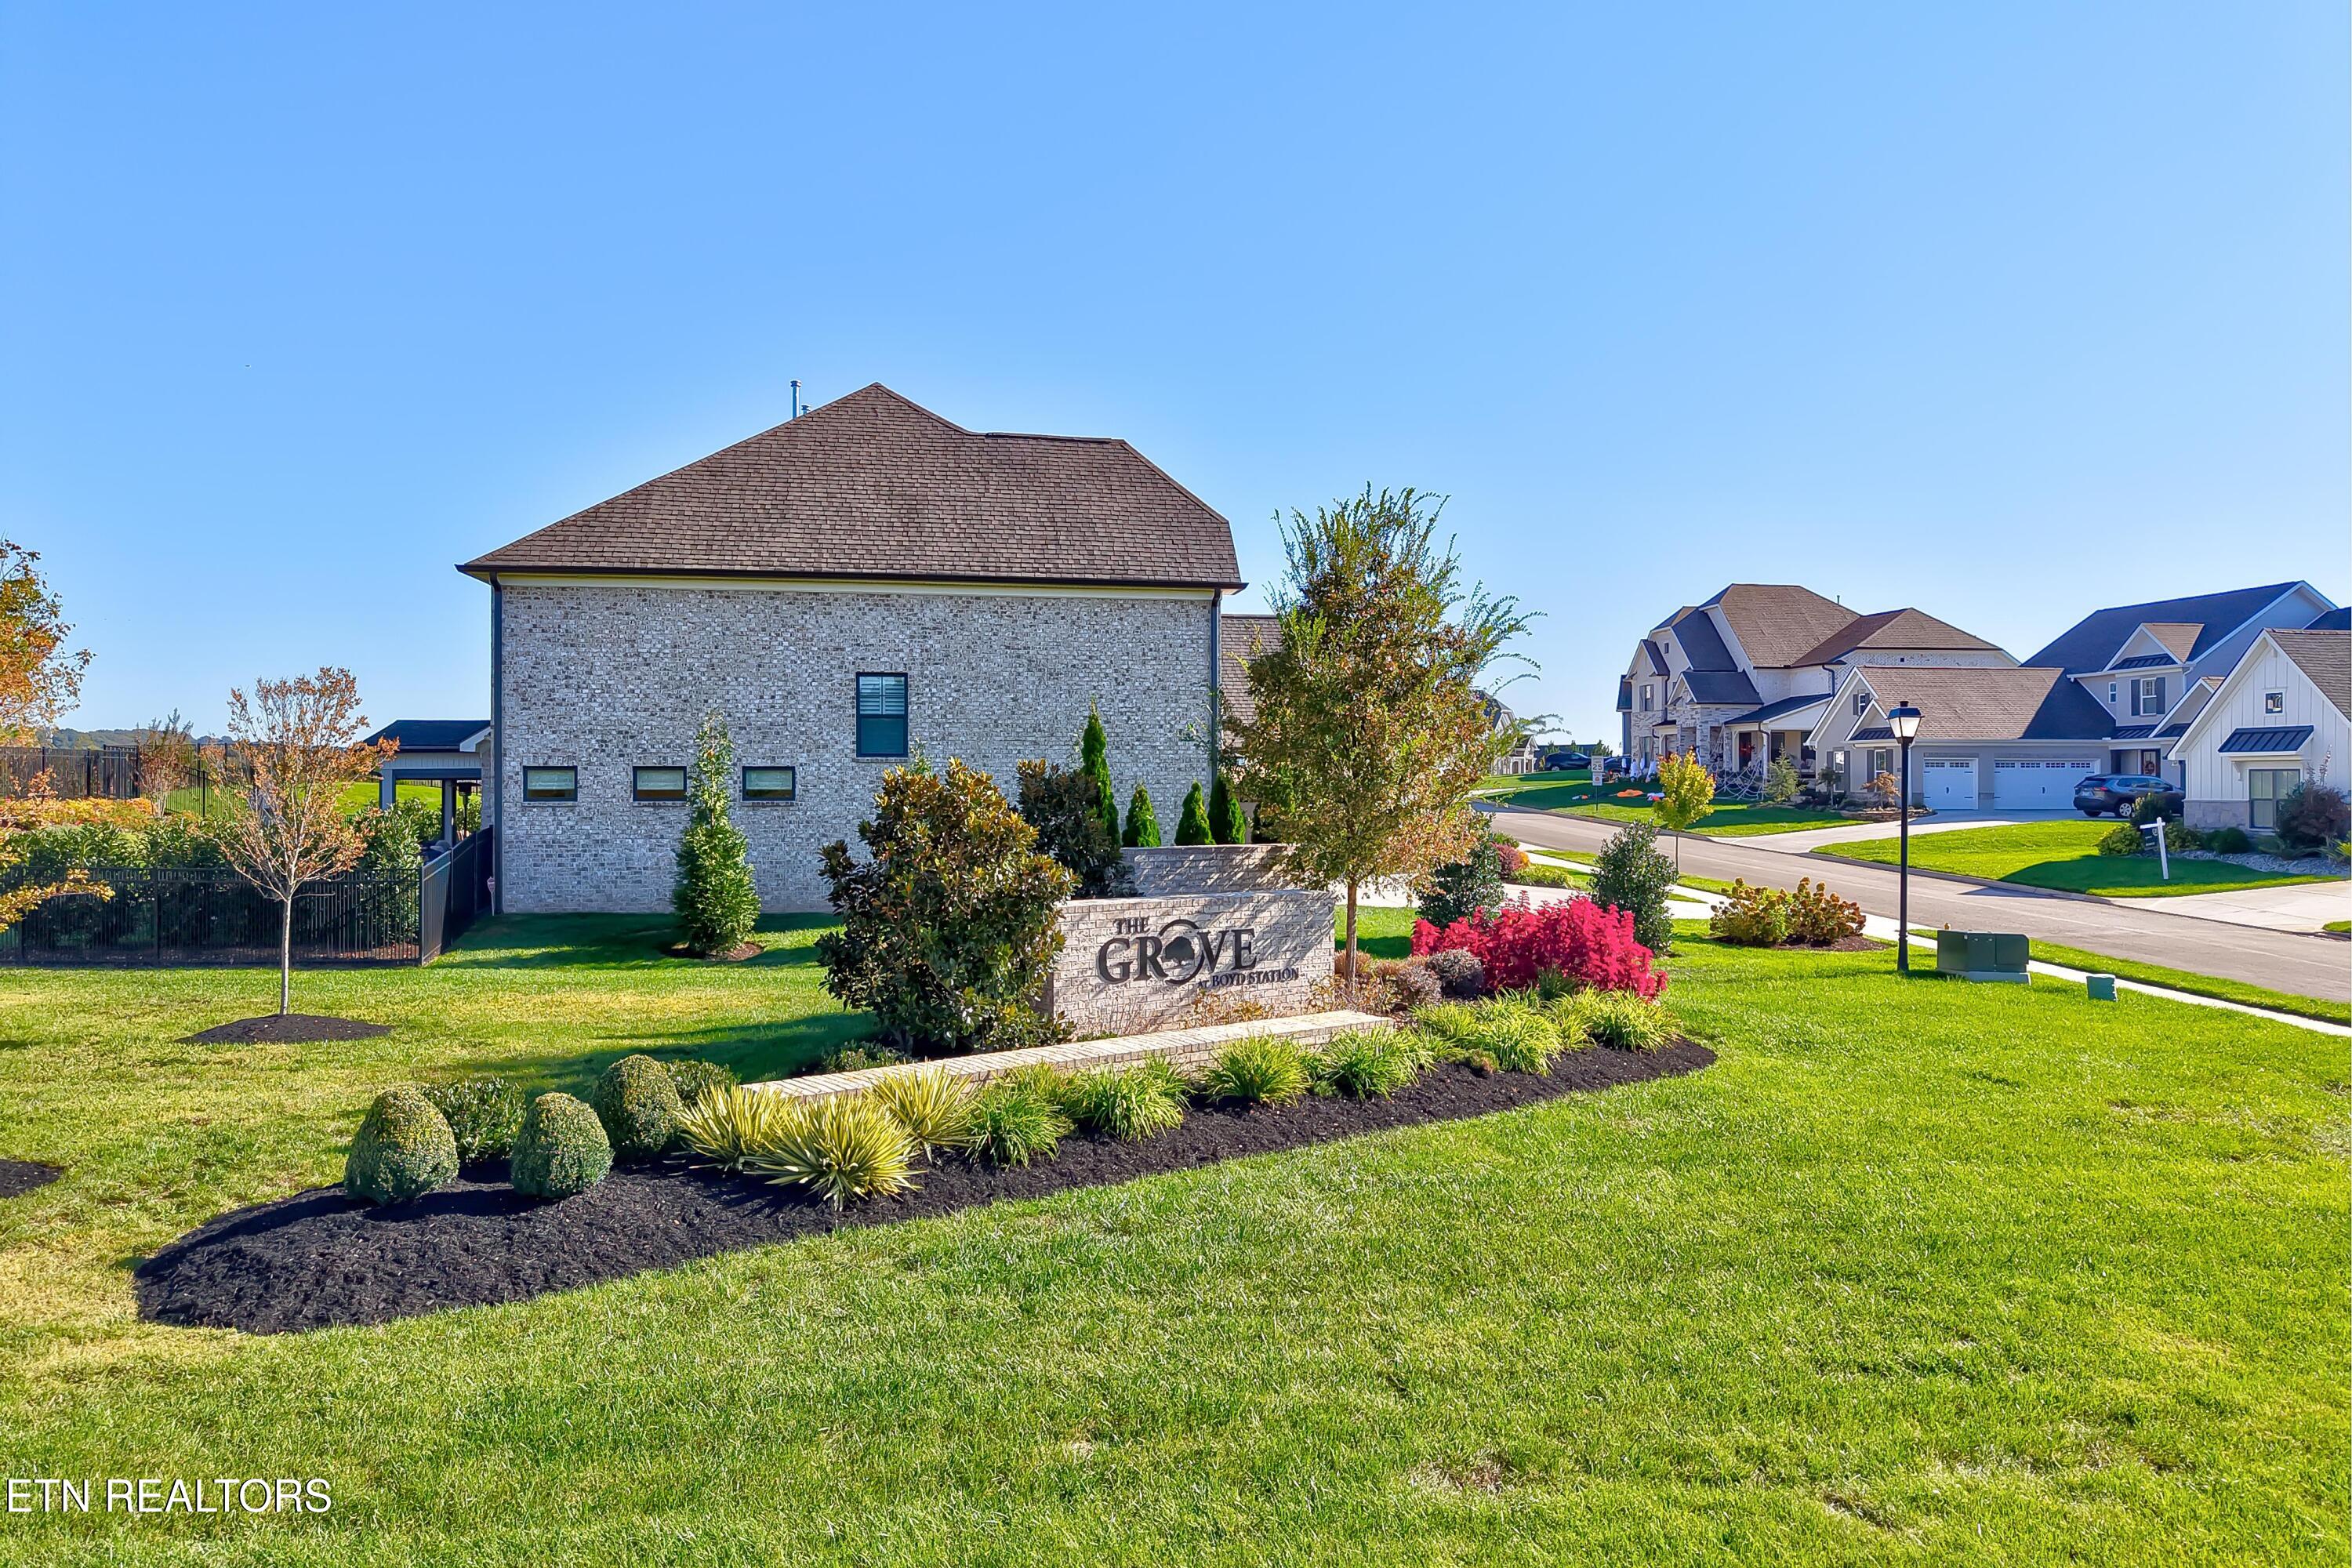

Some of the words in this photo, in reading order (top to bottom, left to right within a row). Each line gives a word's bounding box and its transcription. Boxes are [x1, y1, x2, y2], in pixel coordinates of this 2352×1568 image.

[1113, 917, 1149, 935] THE
[1098, 919, 1258, 985] GROVE
[1197, 979, 1209, 988] AT
[1212, 972, 1246, 987] BOYD
[1249, 967, 1299, 984] STATION
